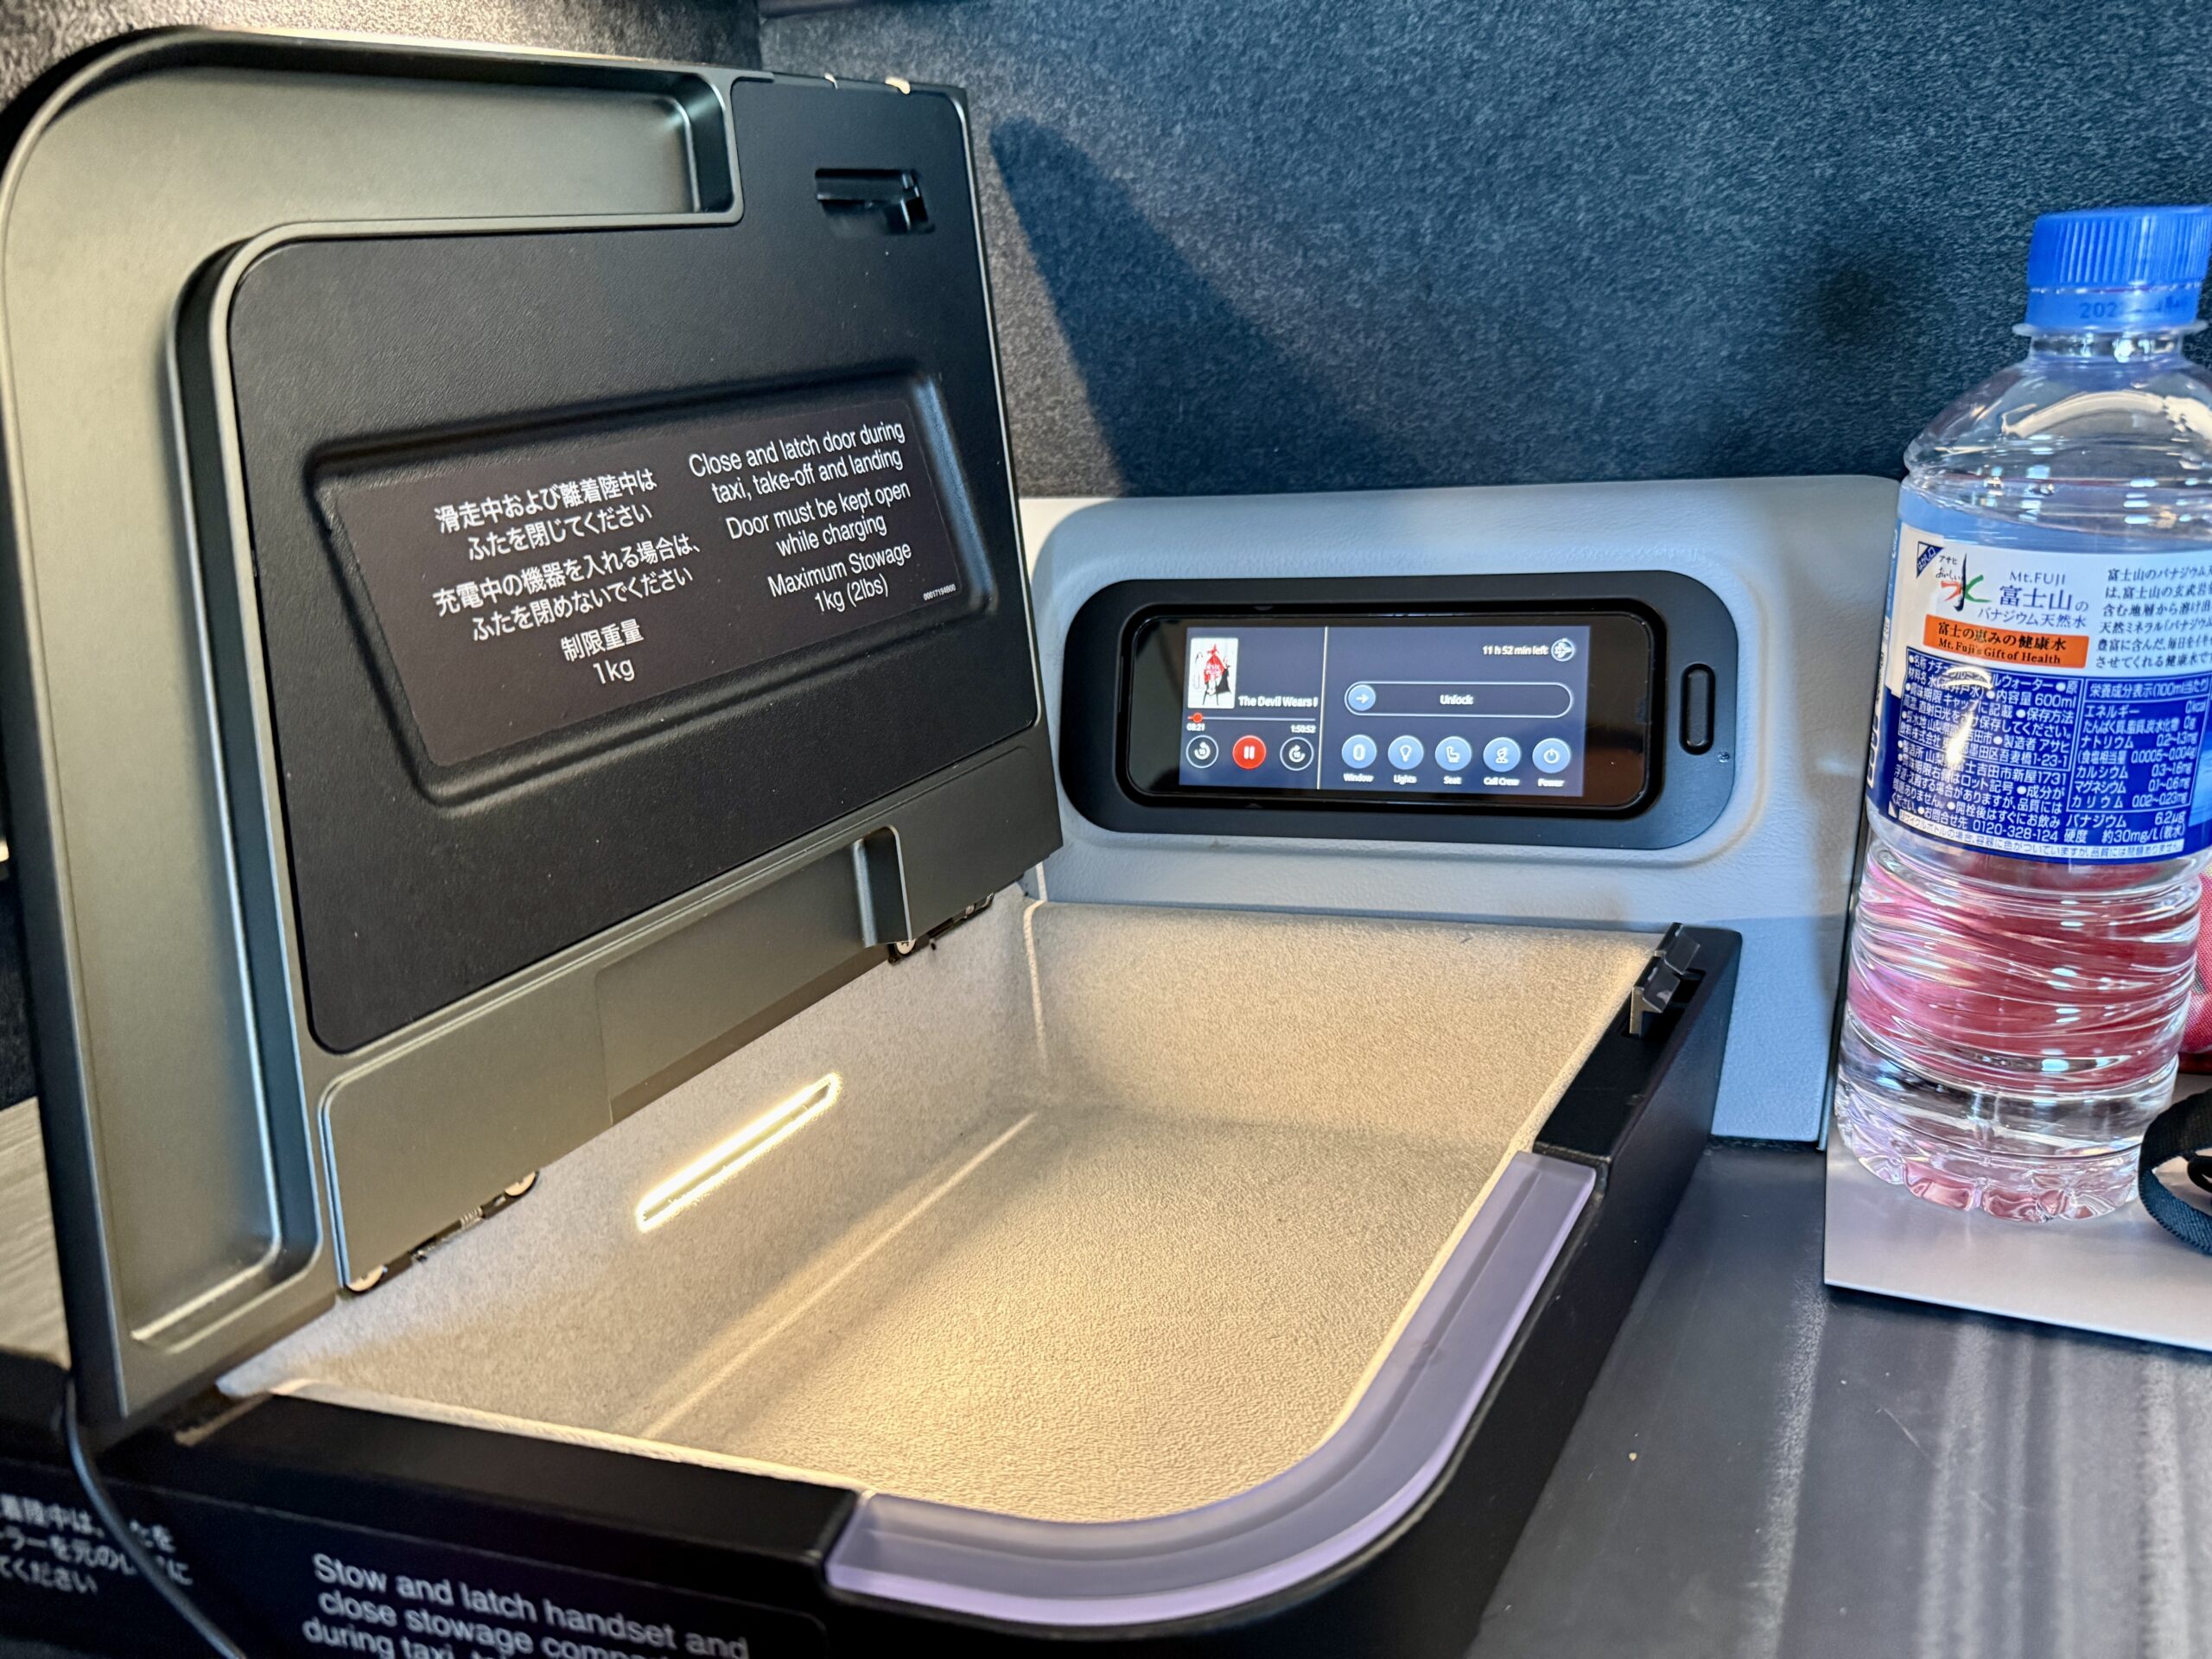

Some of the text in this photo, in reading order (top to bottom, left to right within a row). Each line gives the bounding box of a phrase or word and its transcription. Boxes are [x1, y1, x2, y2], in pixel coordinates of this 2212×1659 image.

[689, 422, 906, 477] Close and latch door during
[711, 448, 904, 504] taxi, take-off and landing
[434, 468, 657, 534] 滑走中および離着陸中は
[726, 482, 912, 540] Door must be kept open
[467, 503, 652, 561] ふたを閉じてください
[776, 514, 887, 557] while charging
[1939, 555, 1957, 565] アサヒ
[433, 533, 700, 617] 充電中の機器を入れる場合は、
[767, 543, 912, 597] Maximum Stowage
[2009, 570, 2066, 586] Mt.FUJI
[815, 574, 889, 613] 1kg (2lbs)
[472, 567, 693, 641] ふたを閉めないでください
[1978, 607, 2087, 628] バナジウム天然水
[561, 618, 644, 662] 制限重量
[1938, 620, 2067, 652] 富士の恵みの健康水
[1483, 645, 1549, 655] 11 h 52 min left
[1938, 638, 1954, 649] Mt.
[1984, 647, 2005, 659] Gift
[2006, 650, 2019, 661] of
[2021, 651, 2061, 664] Health
[2095, 651, 2212, 669] させてくれる健康水で
[593, 658, 635, 684] 1kg
[1238, 696, 1256, 707] The
[1257, 696, 1281, 707] Devil
[1282, 696, 1313, 708] Wears
[1440, 694, 1474, 705] Unlock
[2034, 693, 2076, 708] 600ml
[2027, 707, 2075, 724] 保存方法
[2084, 703, 2140, 718] エネルギー
[2039, 739, 2070, 753] アサヒ
[2080, 734, 2134, 749] ナトリウム
[1343, 773, 1374, 783] Window
[1394, 775, 1417, 785] Lights
[1443, 776, 1462, 785] Seat
[2075, 766, 2129, 779] カルシウム
[1484, 777, 1520, 786] Call Crew
[1537, 779, 1565, 787] Power
[2074, 779, 2126, 794] マグネシウム
[2026, 785, 2065, 800] 成分が
[2066, 813, 2126, 829] バナジウム
[1973, 819, 2058, 842] 0120-328-124
[2063, 828, 2088, 843] 硬度
[312, 1552, 750, 1659] Stow and latch handset and
[318, 1589, 397, 1627] close
[404, 1607, 534, 1657] stowage
[302, 1616, 395, 1659] during
